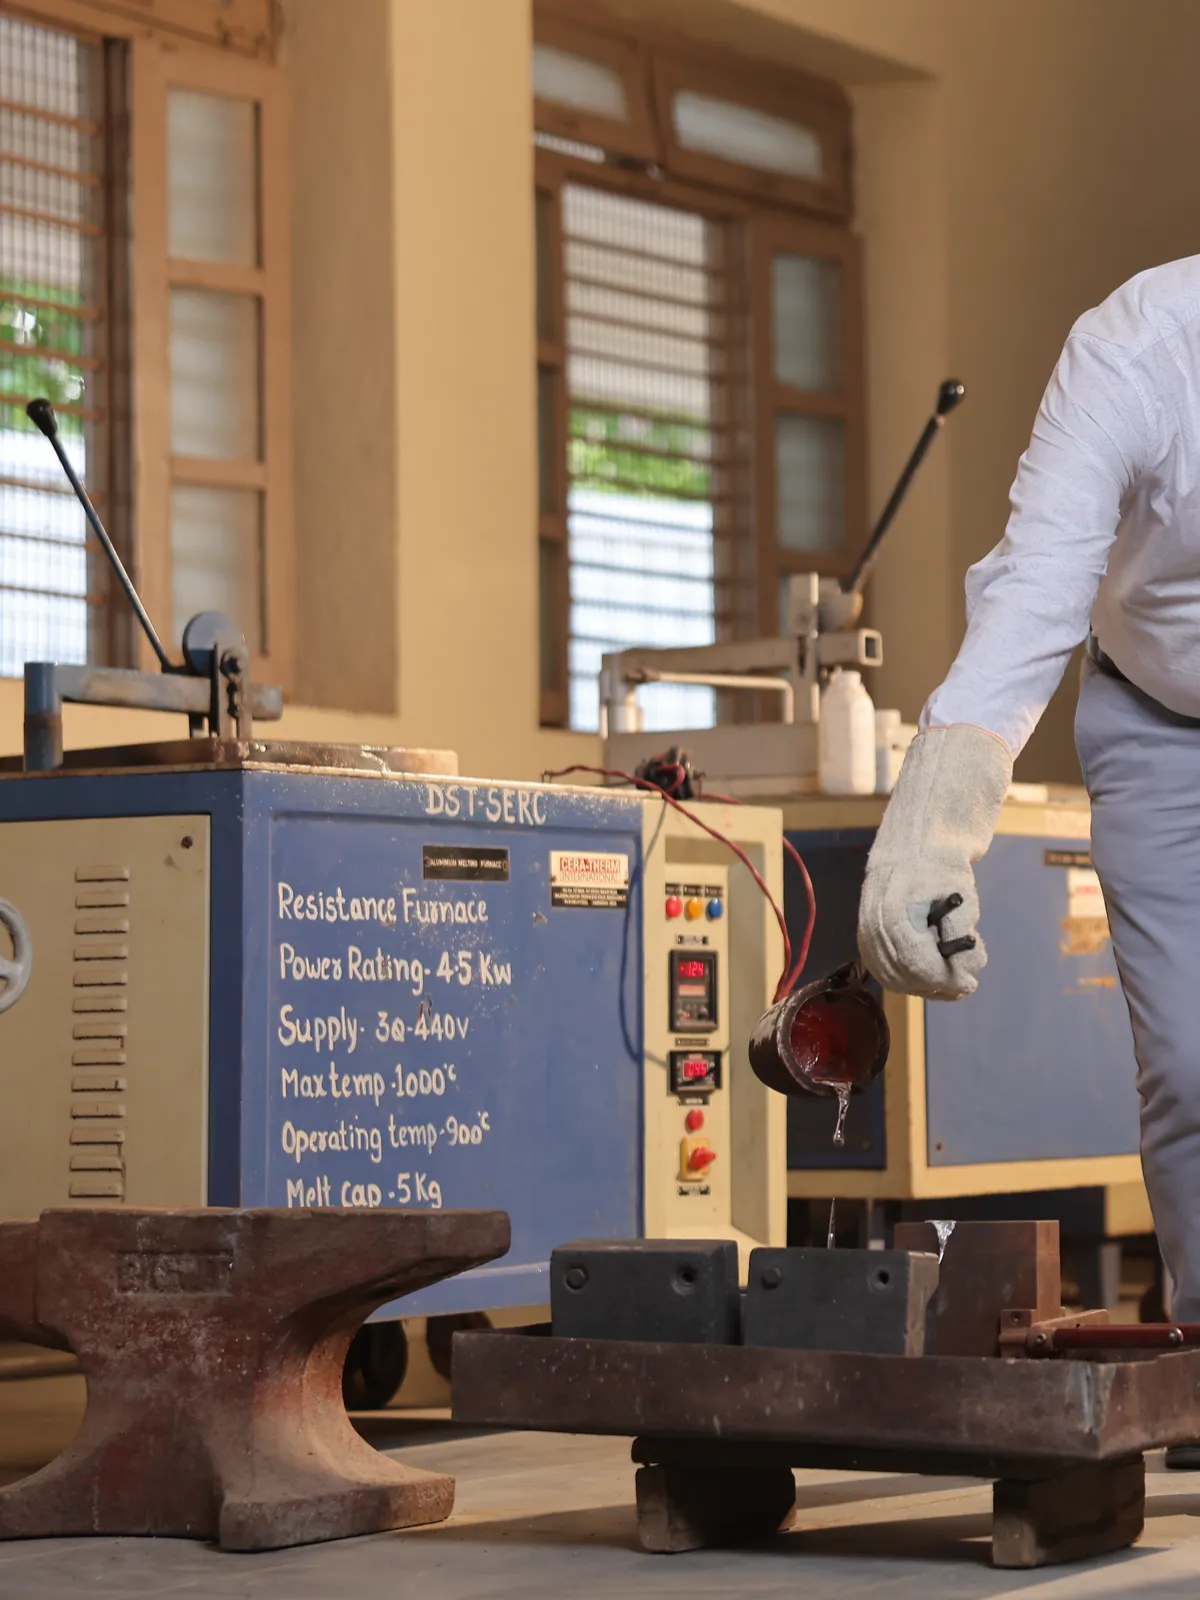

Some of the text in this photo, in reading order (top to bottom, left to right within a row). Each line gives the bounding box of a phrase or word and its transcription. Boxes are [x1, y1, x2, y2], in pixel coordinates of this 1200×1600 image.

[480, 860, 502, 869] FURNACE
[278, 882, 489, 925] Resistance Furnace
[279, 942, 343, 981] Power
[282, 1114, 383, 1164] Operating
[286, 1174, 331, 1208] Melt
